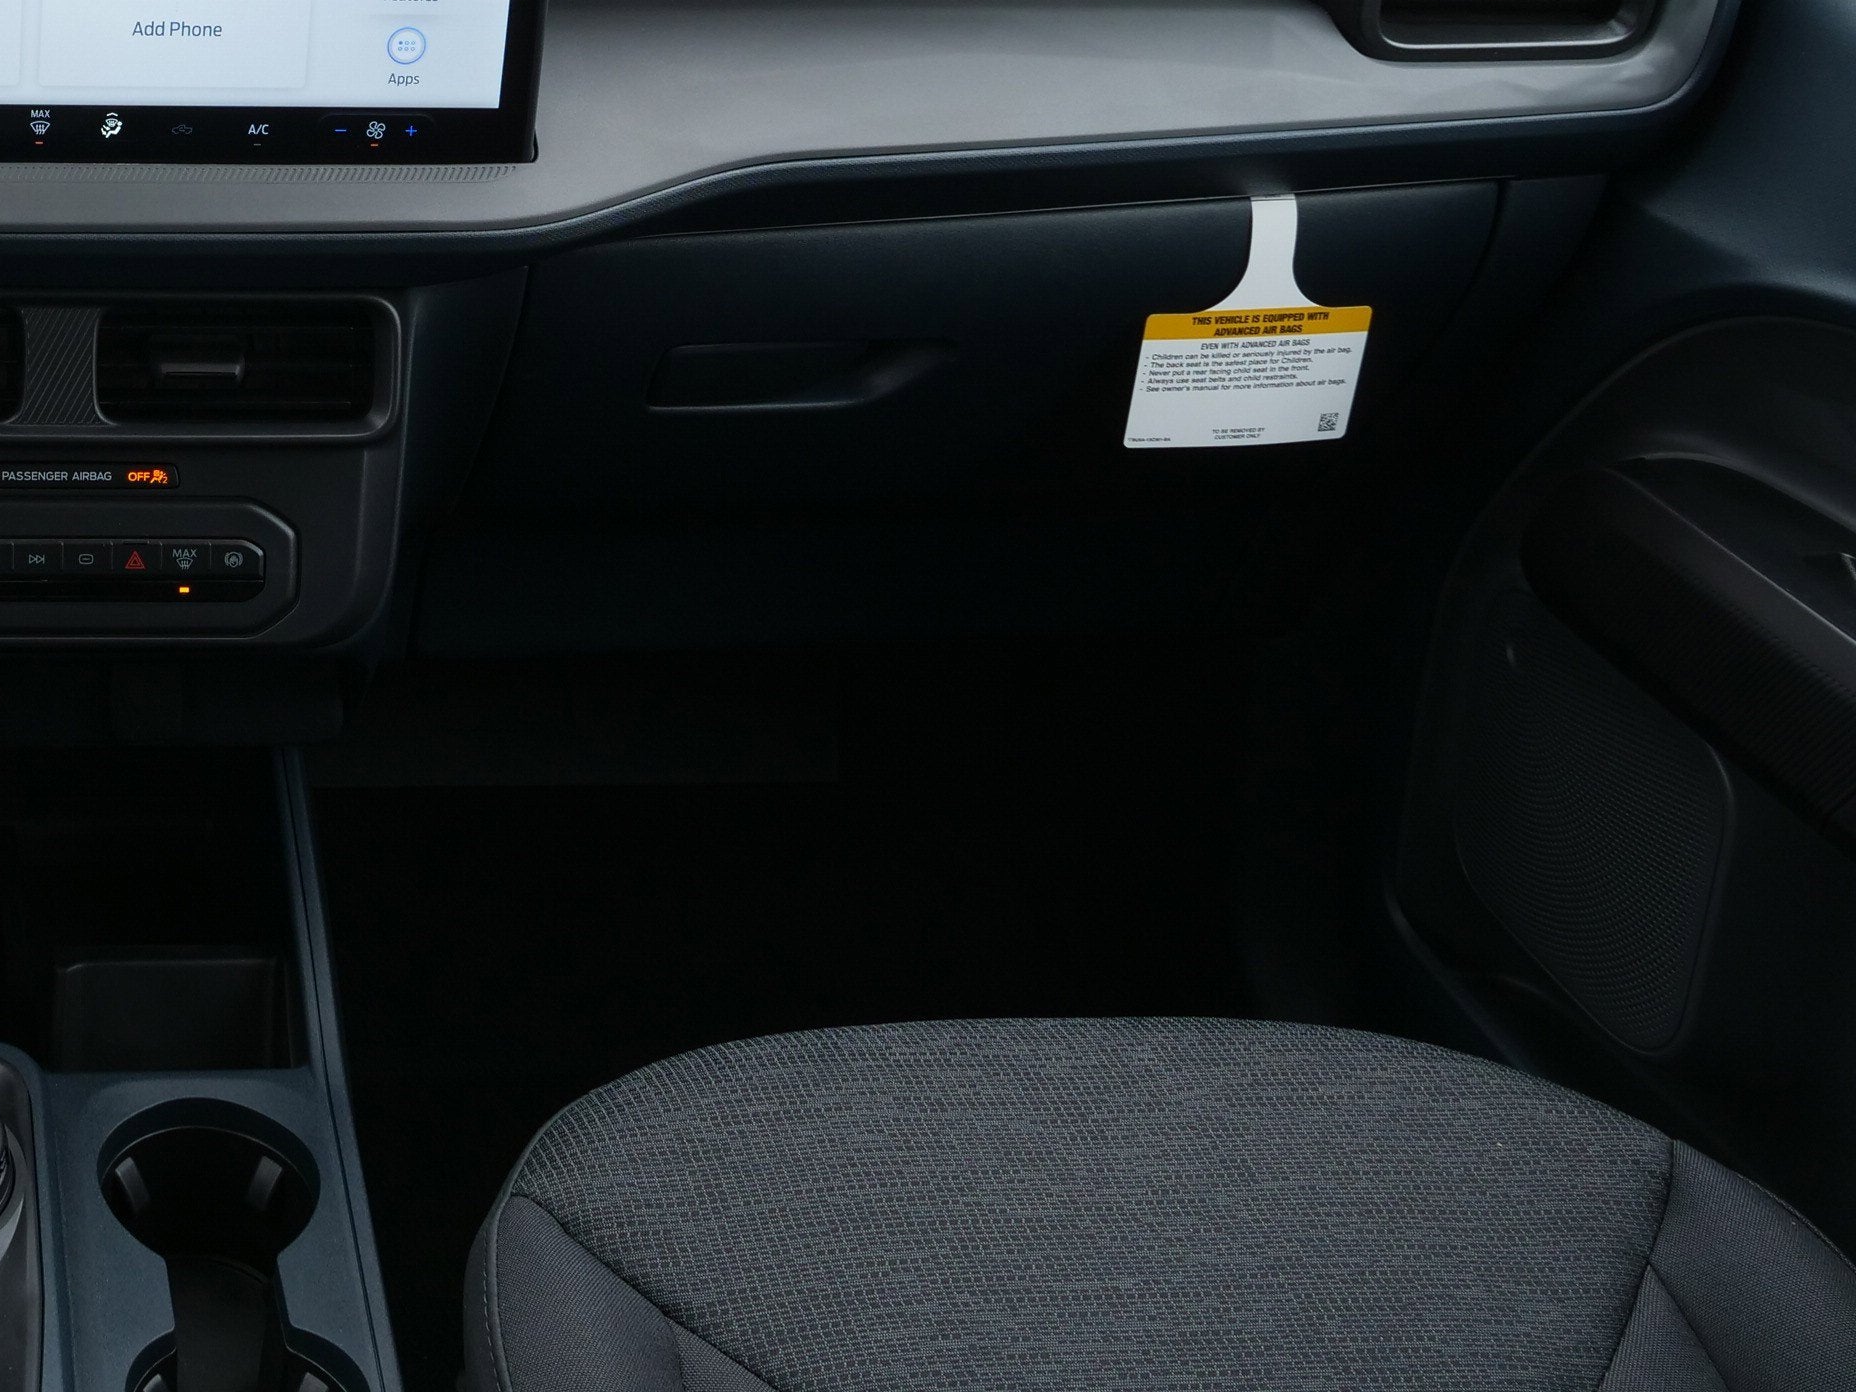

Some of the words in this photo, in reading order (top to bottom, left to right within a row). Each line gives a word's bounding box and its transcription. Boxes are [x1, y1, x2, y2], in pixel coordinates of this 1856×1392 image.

[132, 20, 165, 37] Add
[168, 20, 223, 37] Phone
[387, 72, 421, 88] Apps
[30, 109, 51, 119] MAX
[247, 123, 270, 136] A/C
[1192, 316, 1212, 326] THIS
[1214, 315, 1250, 325] VEHICLE
[1252, 315, 1260, 323] IS
[1262, 312, 1305, 323] EQUIPPED
[1307, 311, 1330, 321] WITH
[1213, 326, 1261, 337] ADVANCED
[1262, 326, 1278, 335] AIR
[1279, 324, 1303, 334] BAGS
[1200, 342, 1219, 350] EVEN
[1220, 341, 1239, 349] WITH
[1241, 340, 1277, 349] ADVANCED
[1278, 339, 1291, 347] AIR
[1242, 350, 1275, 358] seriously
[1276, 349, 1302, 357] injured
[1209, 368, 1232, 376] facing
[1147, 377, 1174, 385] Always
[1262, 373, 1298, 381] restraints.
[1146, 385, 1160, 393] See
[1161, 384, 1191, 392] owner's
[1252, 381, 1294, 389] information
[1, 470, 68, 482] PASSENGER
[72, 470, 113, 483] AIRBAG
[127, 470, 151, 483] OFF
[172, 548, 198, 559] MAX
